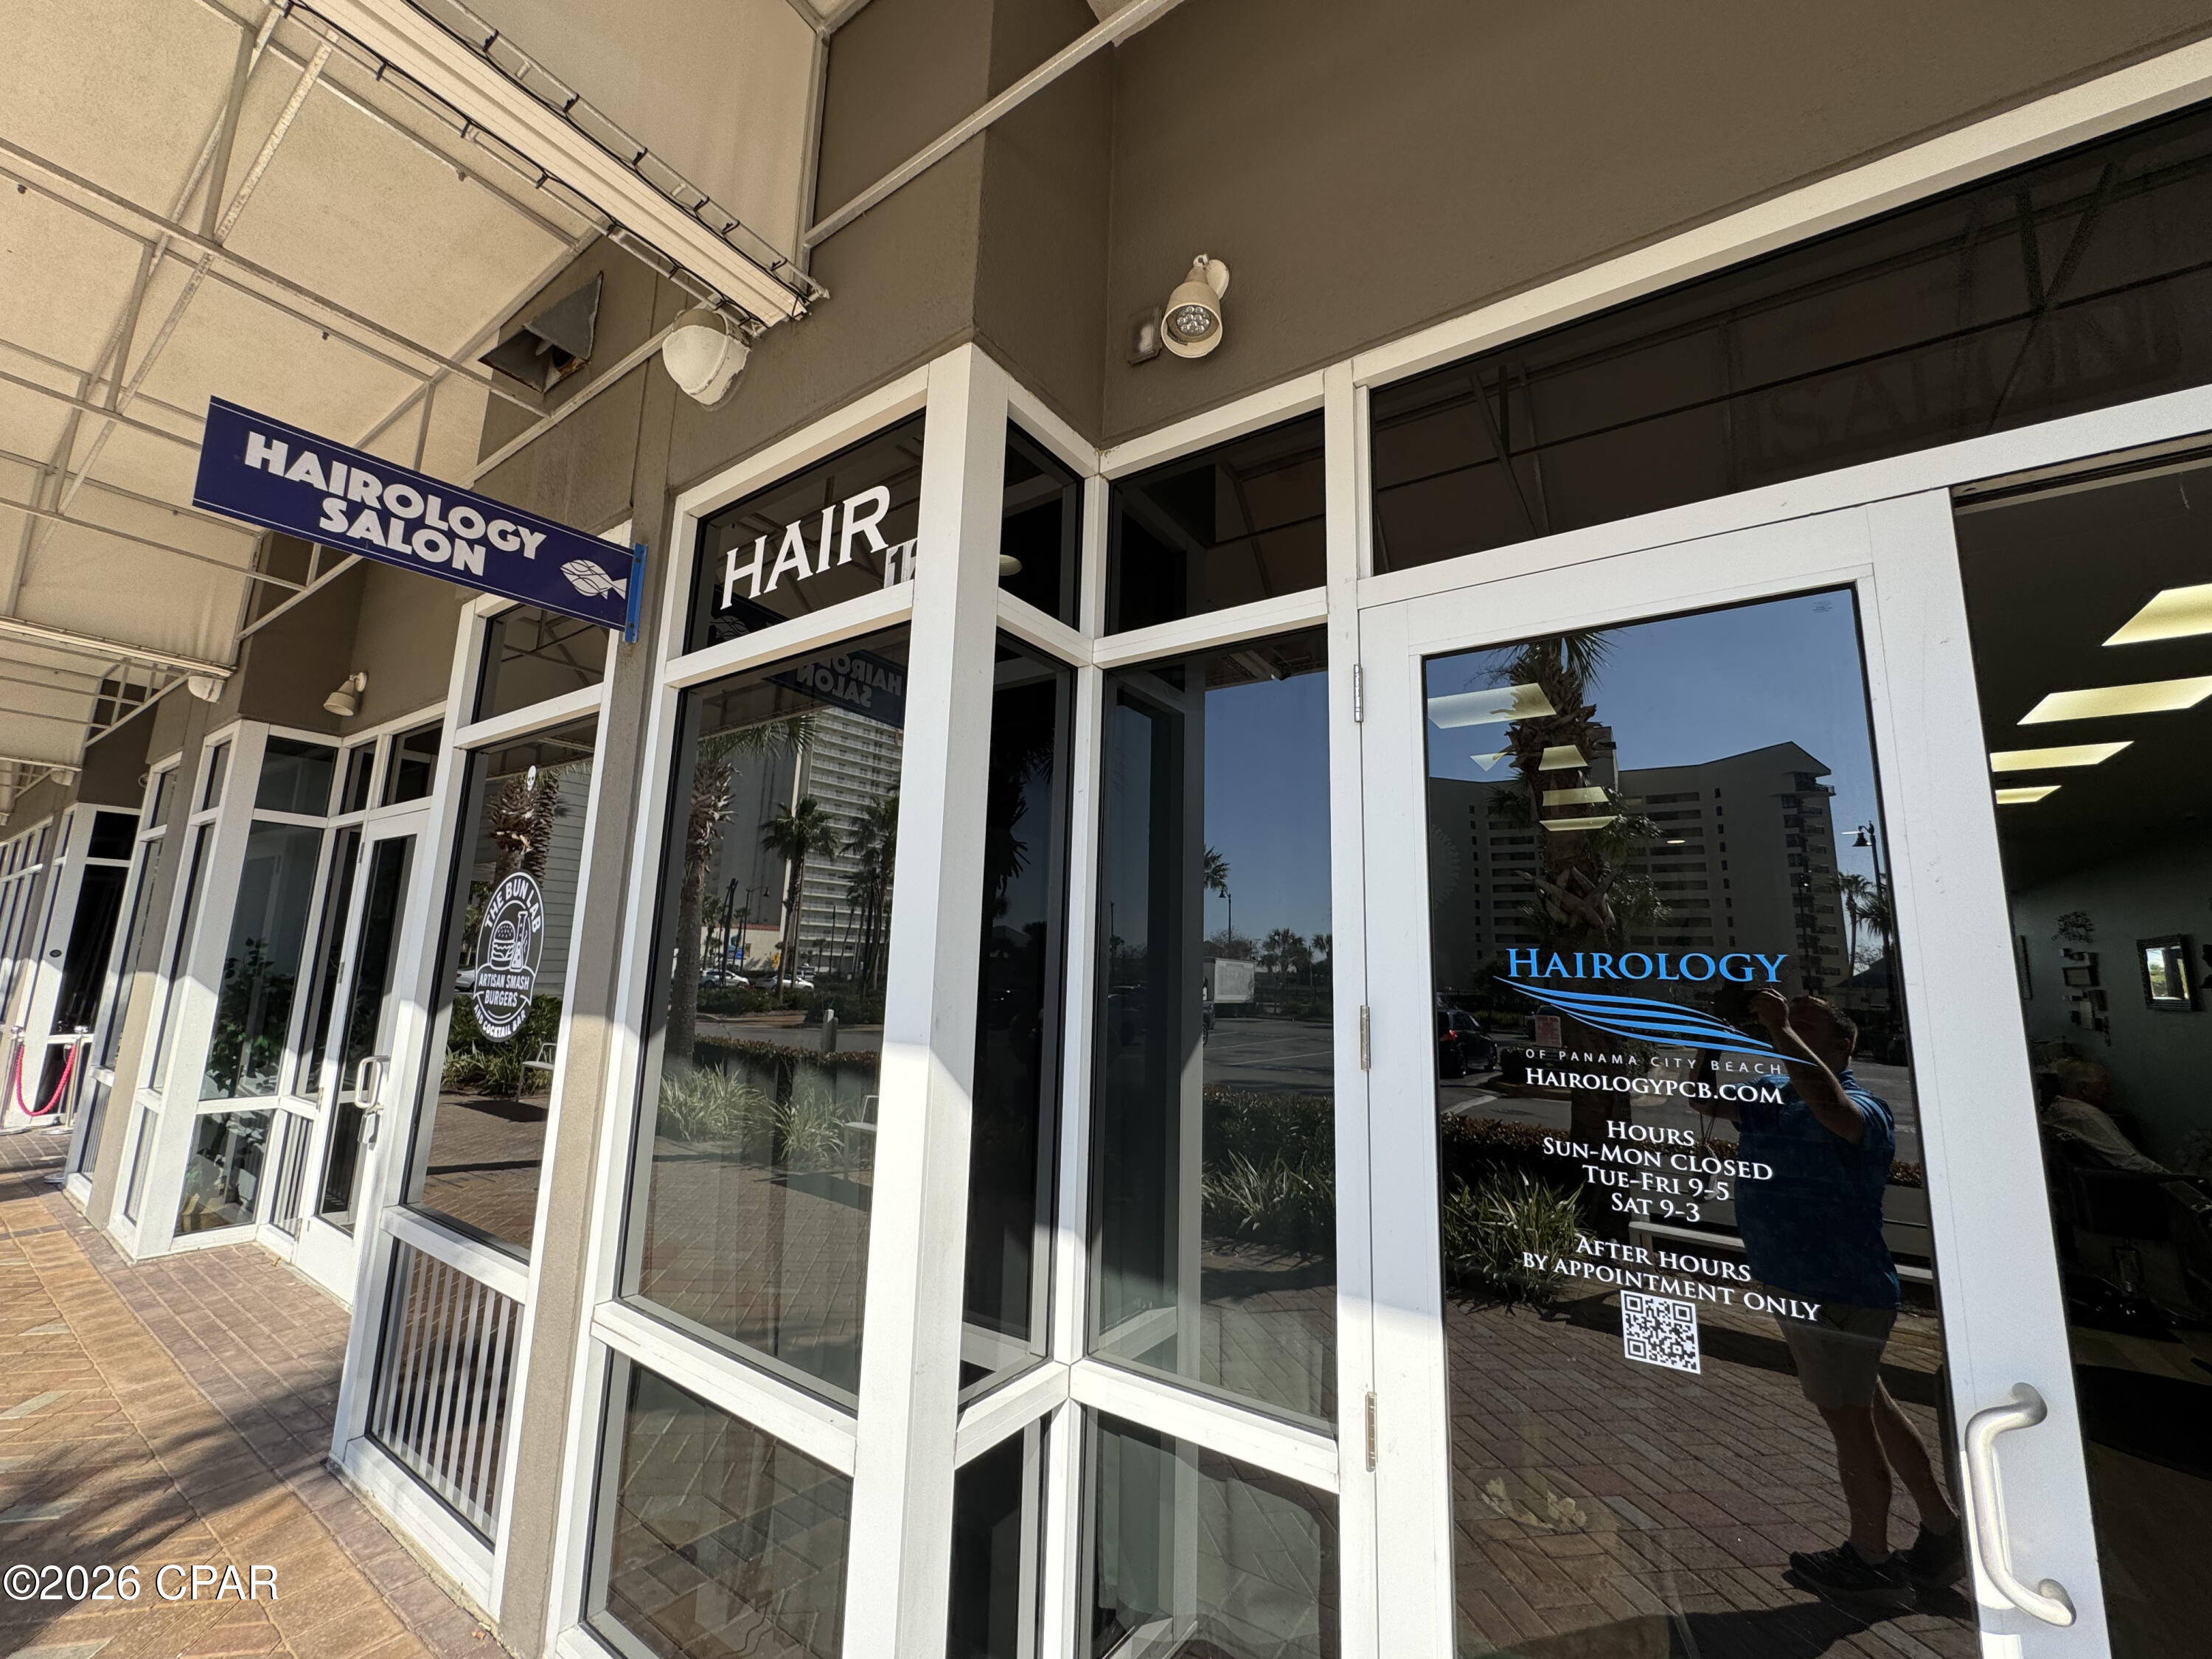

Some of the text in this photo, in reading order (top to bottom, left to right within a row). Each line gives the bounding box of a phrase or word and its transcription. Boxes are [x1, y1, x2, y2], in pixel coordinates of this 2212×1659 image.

[244, 431, 546, 559] HAIROLOGY
[319, 497, 487, 577] SALON
[720, 485, 891, 610] HAIR
[484, 878, 541, 933] THE BUN LAB
[479, 973, 530, 990] ARTISAN SMASH
[1506, 948, 1789, 982] HAIROLOGY
[484, 990, 518, 1007] BURGERS
[473, 1004, 526, 1037] AND COCKTAIL BAR
[1526, 1048, 1781, 1075] OF PANAMA CITY BEACH
[1525, 1067, 1785, 1105] HAIROLOGYPCB.COM
[1606, 1120, 1694, 1147] HOURS
[1543, 1137, 1773, 1180] SUN-MON CLOSED
[1582, 1164, 1730, 1201] TUE-FRI 9-5
[1611, 1192, 1700, 1222] SAT 9-3
[1575, 1236, 1752, 1282] AFTER HOURS
[1522, 1251, 1821, 1322] BY APPOINTMENT ONLY
